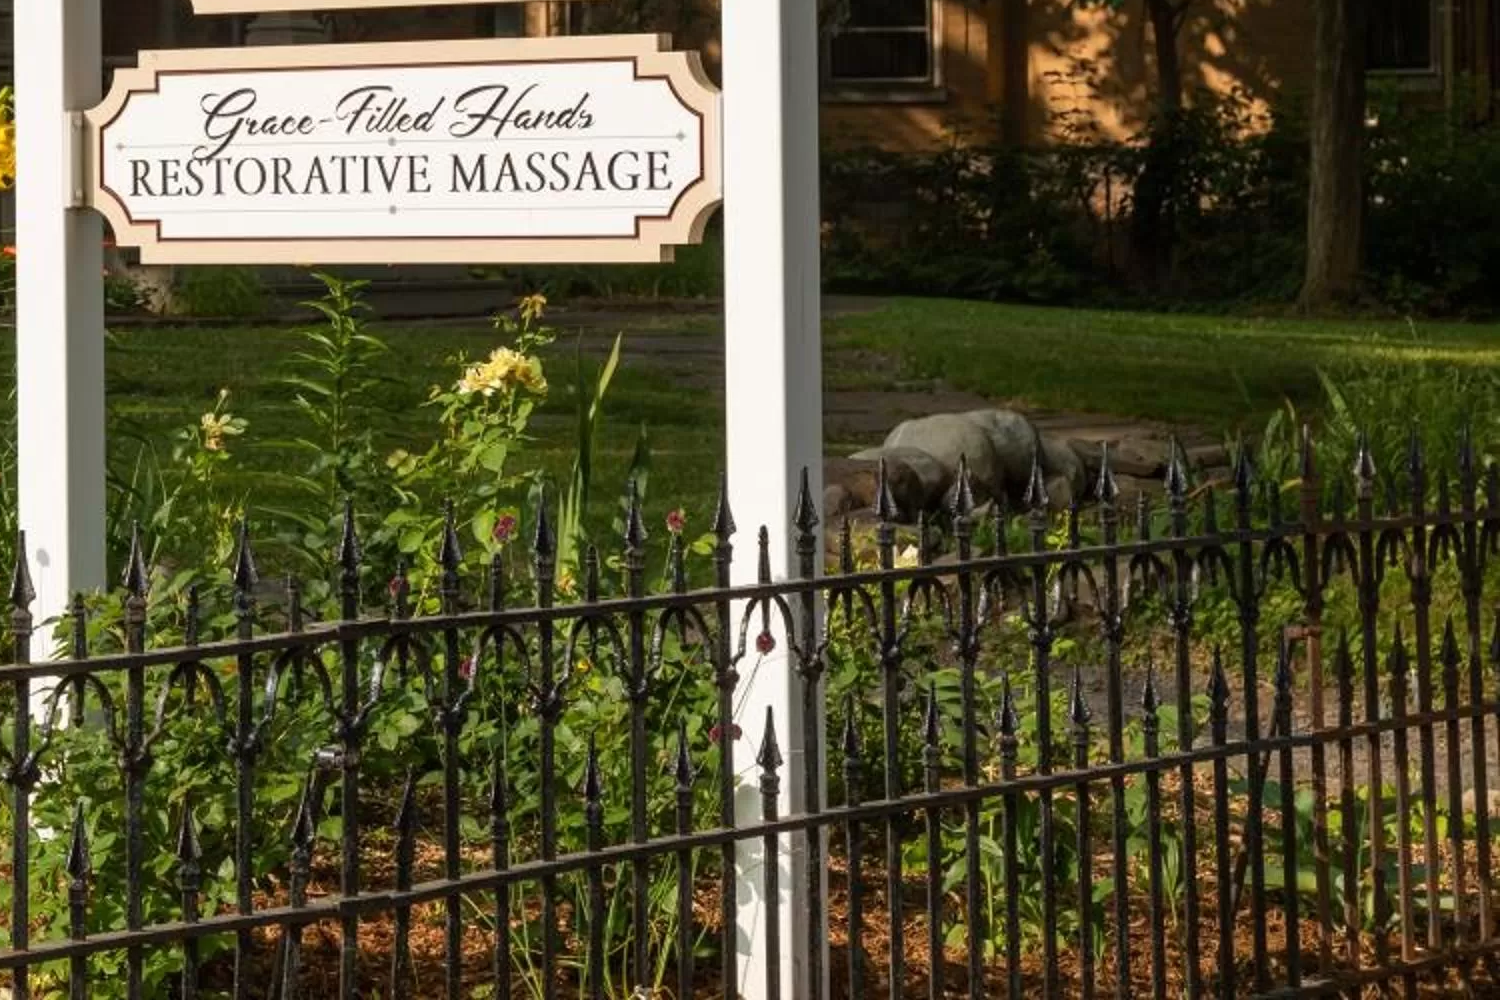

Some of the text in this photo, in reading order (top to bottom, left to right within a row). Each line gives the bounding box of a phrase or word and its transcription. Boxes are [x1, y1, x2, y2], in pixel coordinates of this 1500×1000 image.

[191, 83, 597, 160] Grace-Filled Hands
[128, 149, 674, 198] RESTORATIVE MASSAGE
